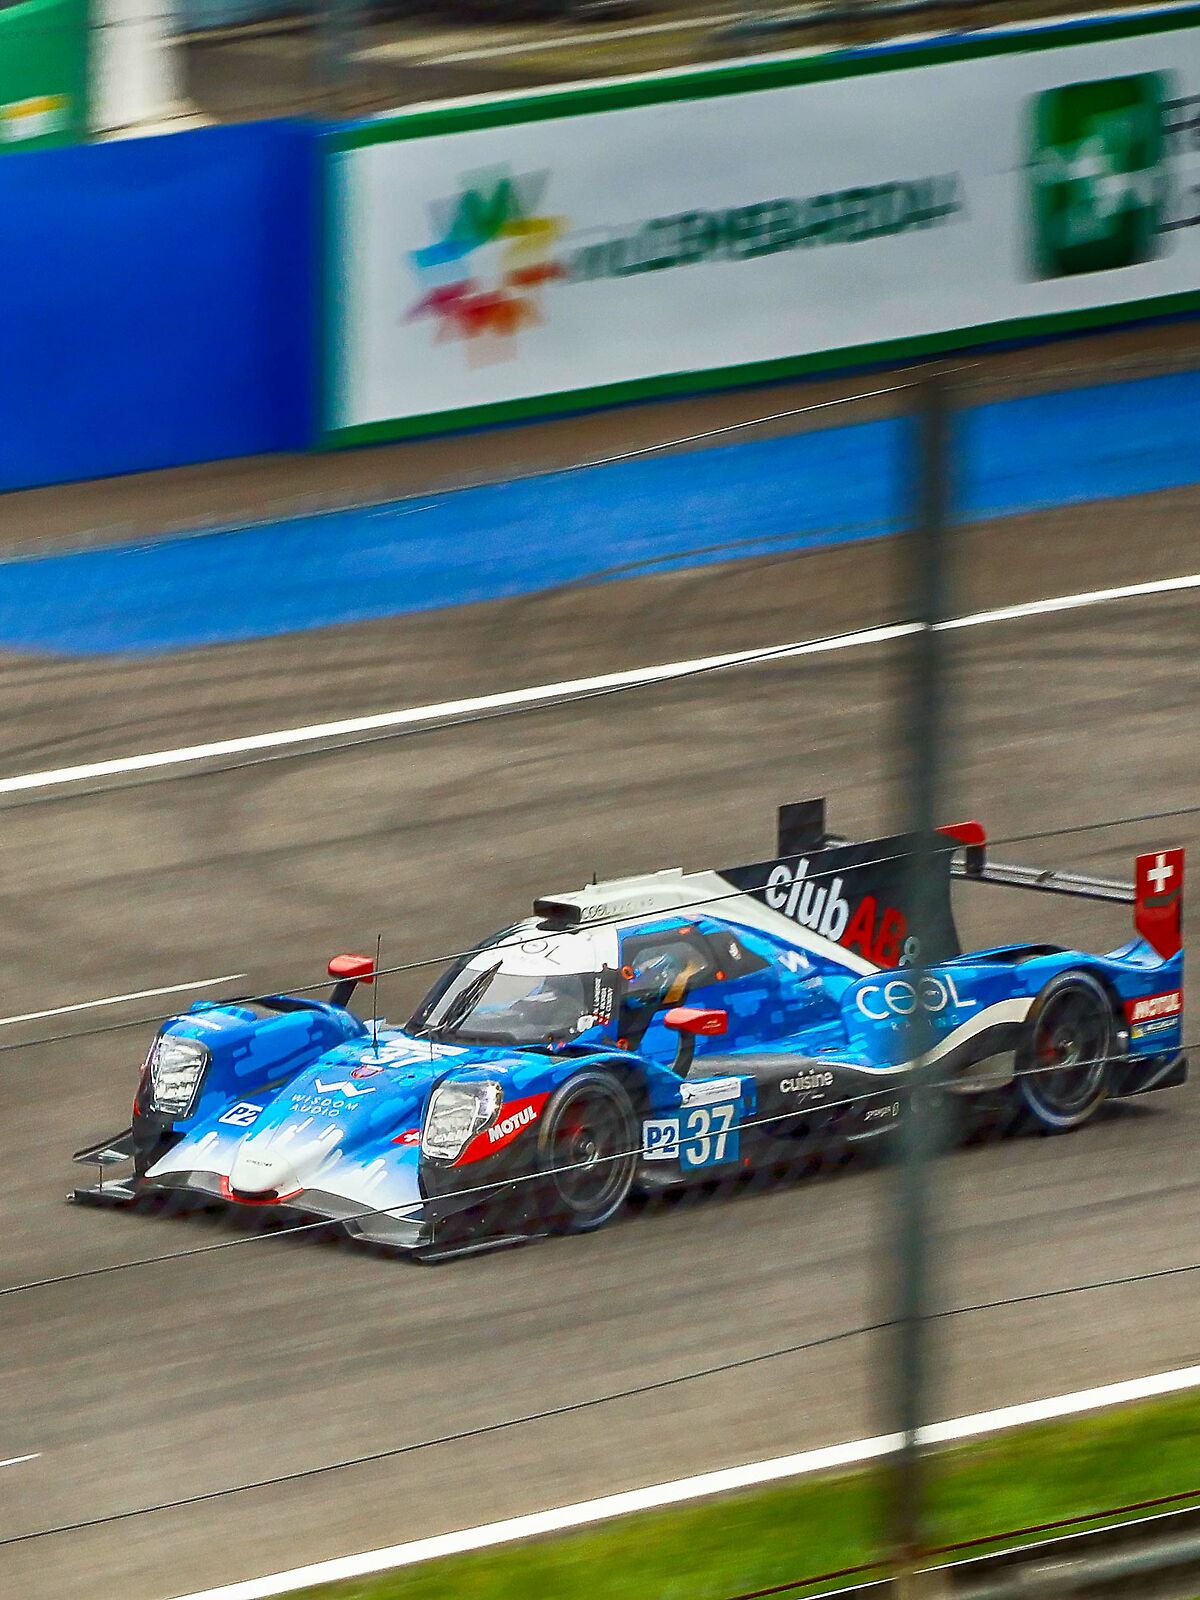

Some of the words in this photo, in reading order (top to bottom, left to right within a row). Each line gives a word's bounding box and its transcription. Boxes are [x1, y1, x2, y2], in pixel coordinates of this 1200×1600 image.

[779, 1069, 834, 1093] cuisine
[289, 1104, 341, 1117] AUDIO
[291, 1093, 360, 1111] WISDOM
[224, 1106, 261, 1123] P2
[487, 1105, 538, 1143] MOTUL
[647, 1126, 675, 1154] P2
[686, 1104, 734, 1165] 37
